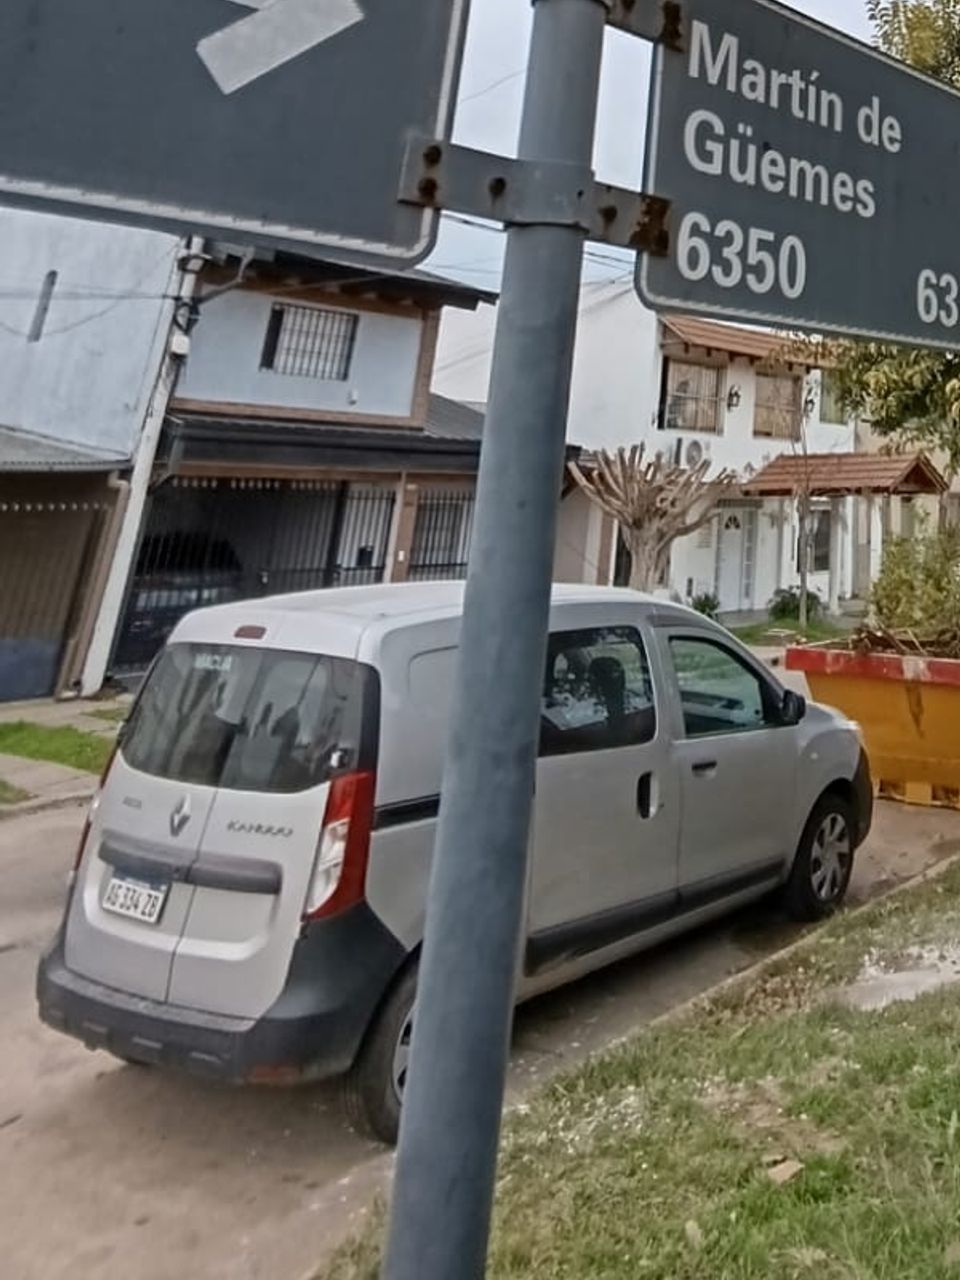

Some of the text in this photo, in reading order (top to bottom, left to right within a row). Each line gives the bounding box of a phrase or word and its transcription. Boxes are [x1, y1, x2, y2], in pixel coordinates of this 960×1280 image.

[688, 20, 902, 153] Martín de
[684, 110, 876, 218] Güemes
[676, 212, 807, 299] 6350
